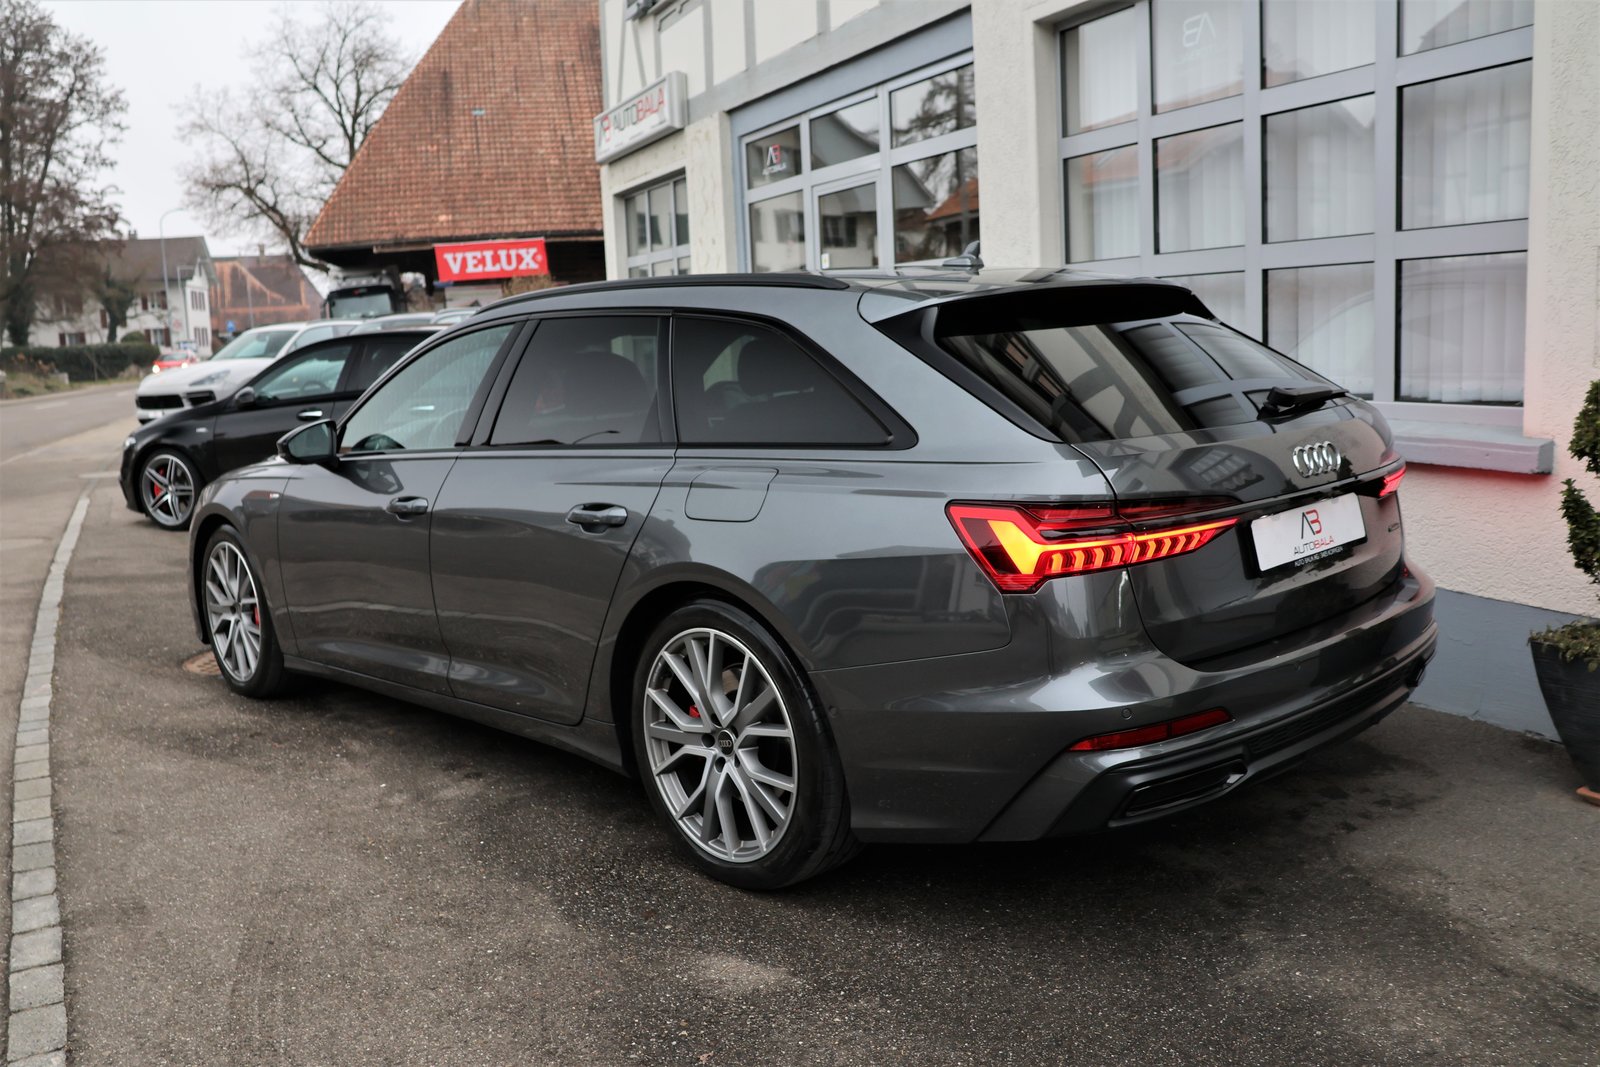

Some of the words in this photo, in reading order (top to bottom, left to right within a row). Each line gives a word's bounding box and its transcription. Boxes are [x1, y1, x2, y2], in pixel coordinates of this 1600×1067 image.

[613, 87, 664, 131] AUTOBALA
[443, 247, 540, 274] VELUX
[1293, 535, 1335, 556] AUTOBALA
